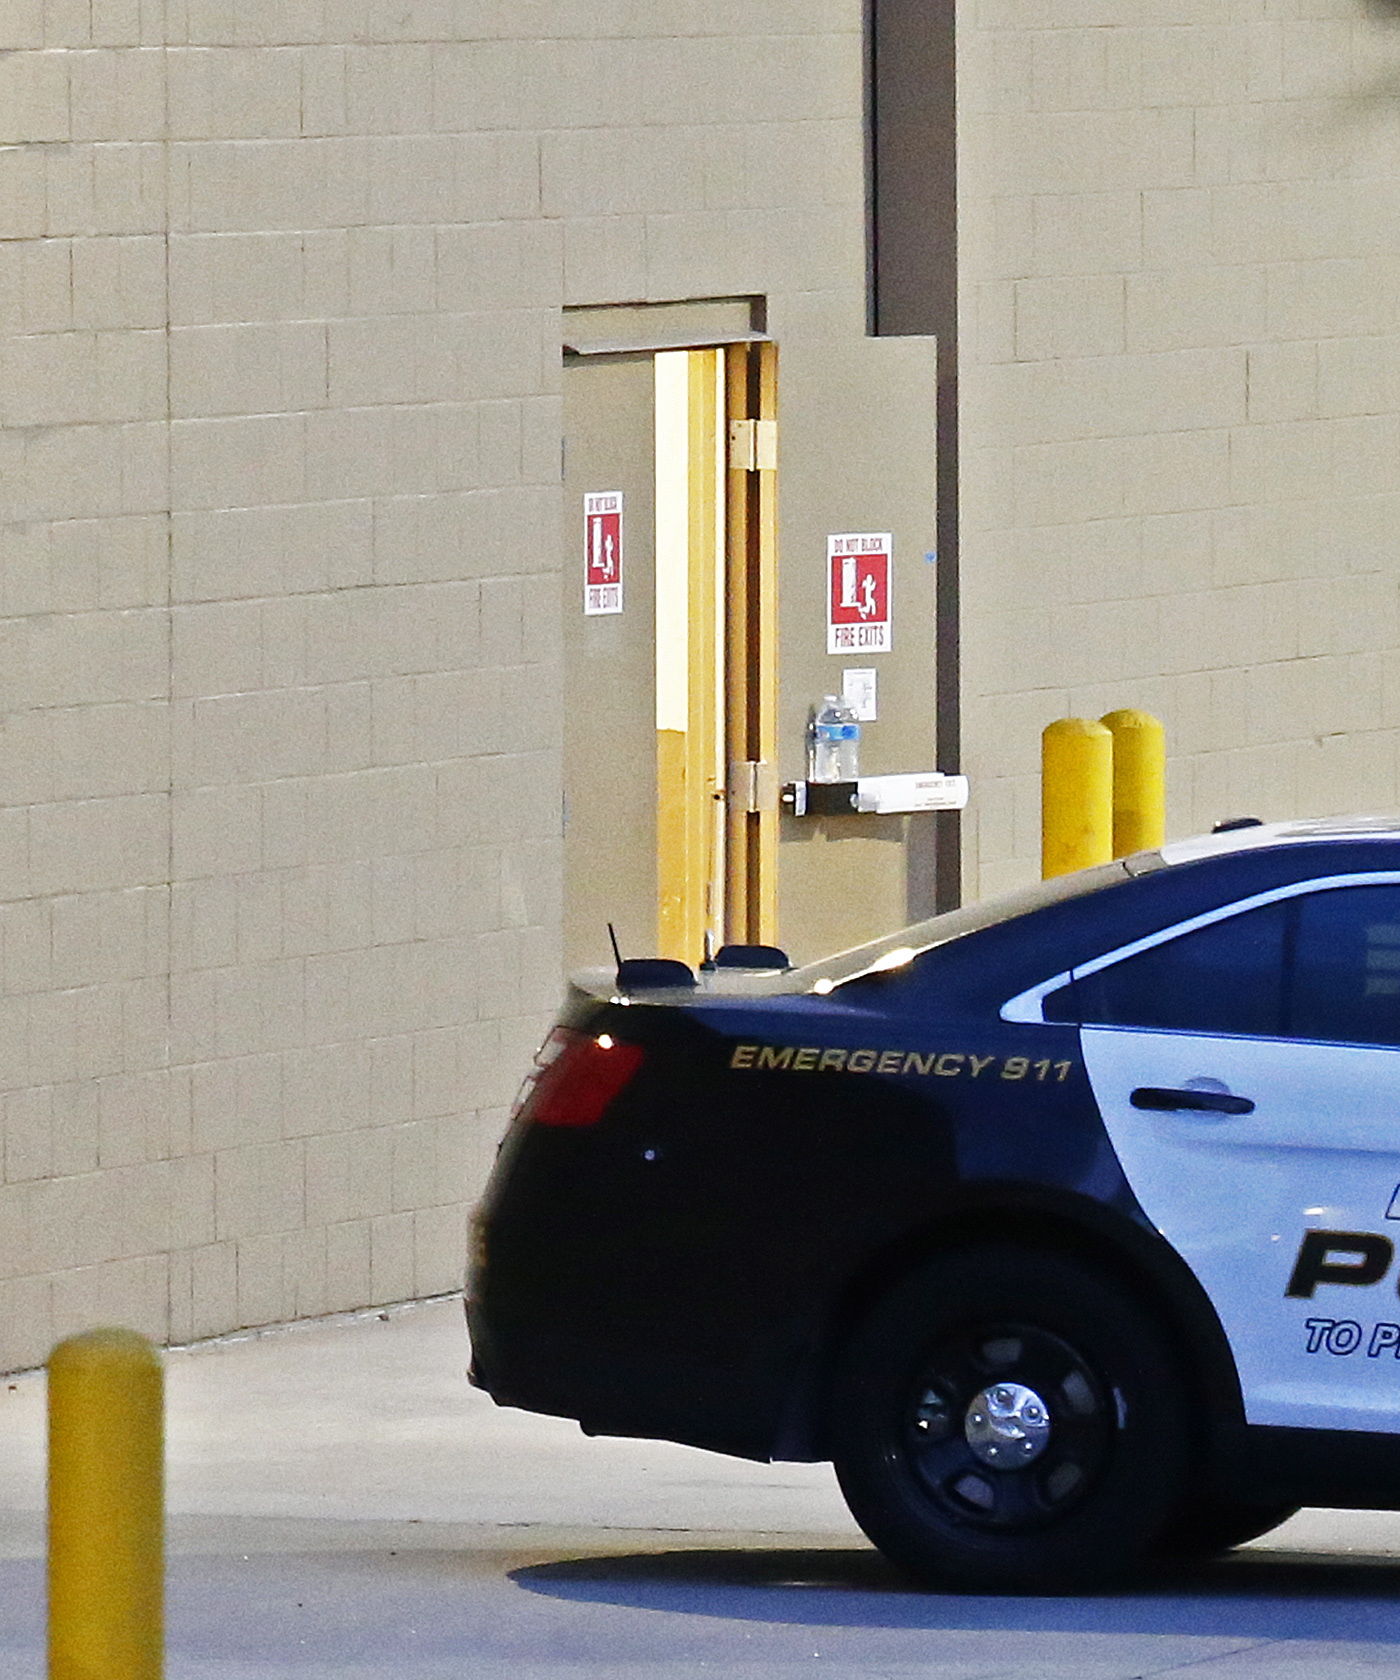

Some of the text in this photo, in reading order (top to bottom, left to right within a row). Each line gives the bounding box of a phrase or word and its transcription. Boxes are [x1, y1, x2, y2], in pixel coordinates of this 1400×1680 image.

[835, 625, 884, 647] FIRE EXITS
[729, 1045, 1073, 1082] EMERGENCY 911
[1304, 1317, 1364, 1356] TO
